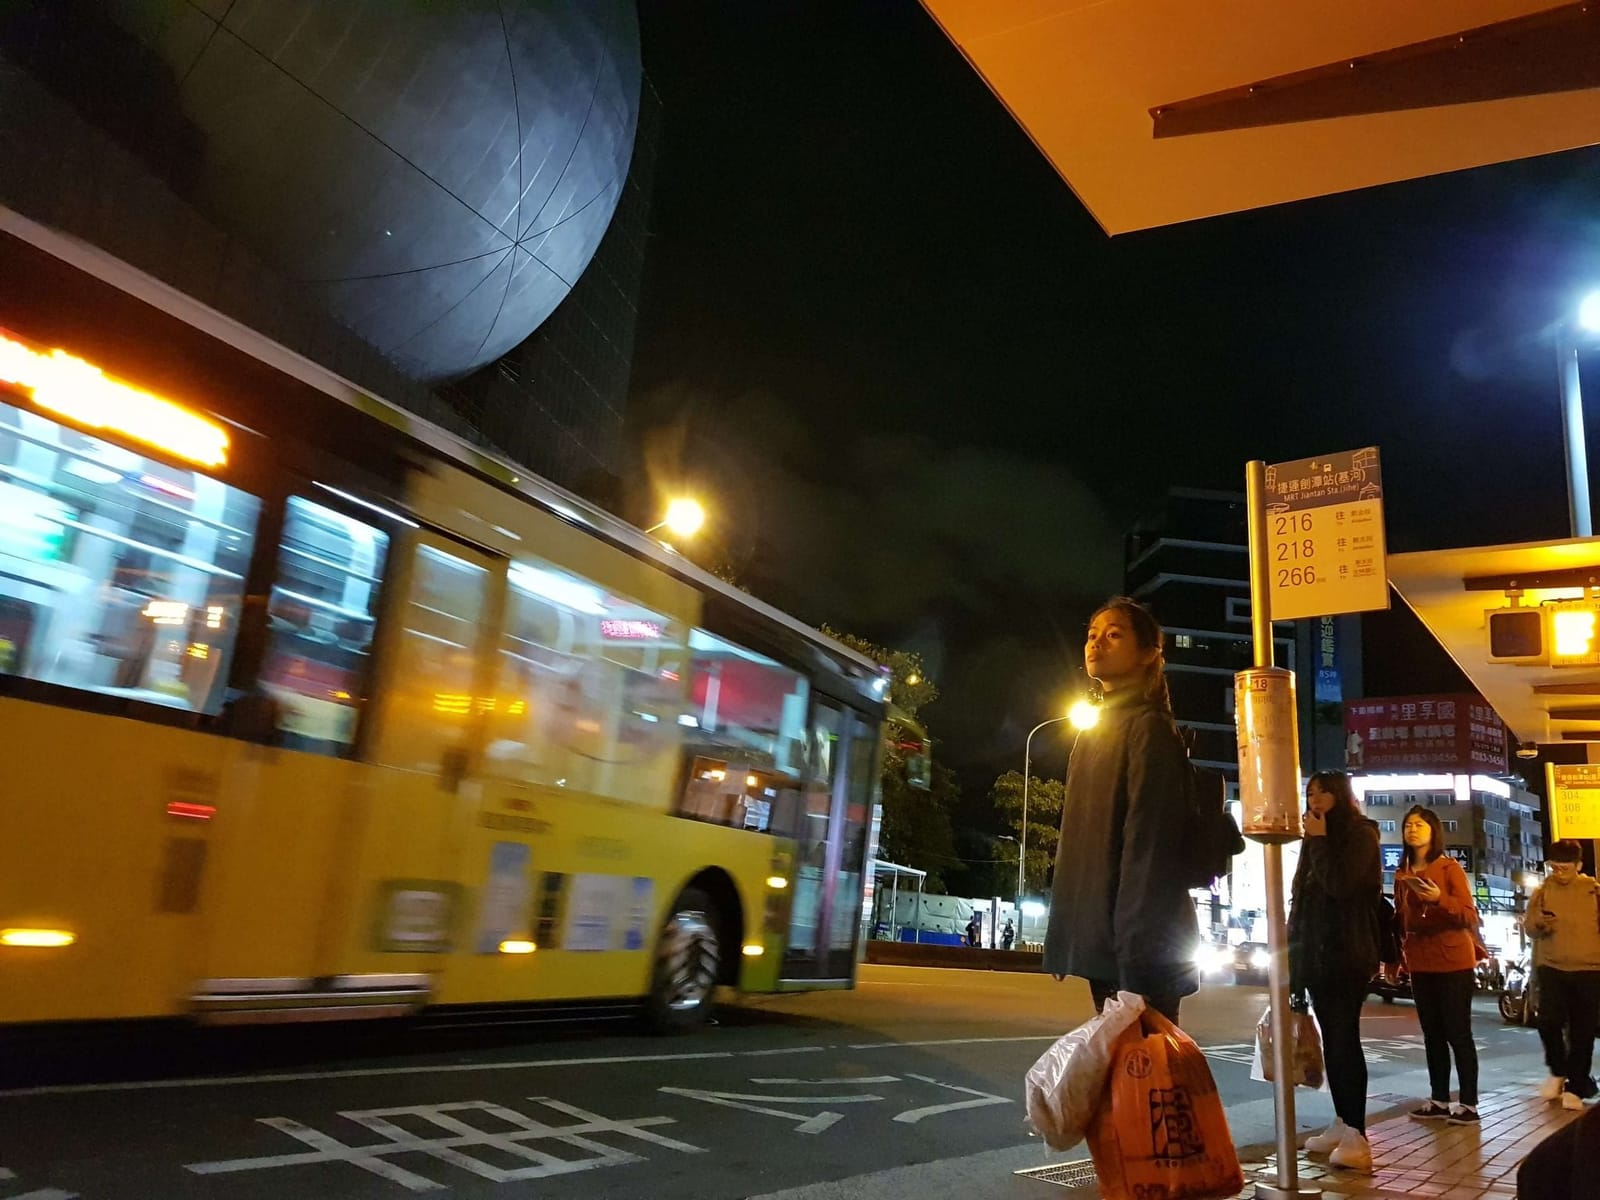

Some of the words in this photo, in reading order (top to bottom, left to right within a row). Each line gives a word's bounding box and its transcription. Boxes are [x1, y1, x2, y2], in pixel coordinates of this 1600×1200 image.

[1283, 492, 1299, 502] MRT
[1301, 488, 1326, 501] Jiantan
[1275, 513, 1313, 536] 216
[1277, 539, 1315, 561] 218
[1278, 565, 1316, 588] 266
